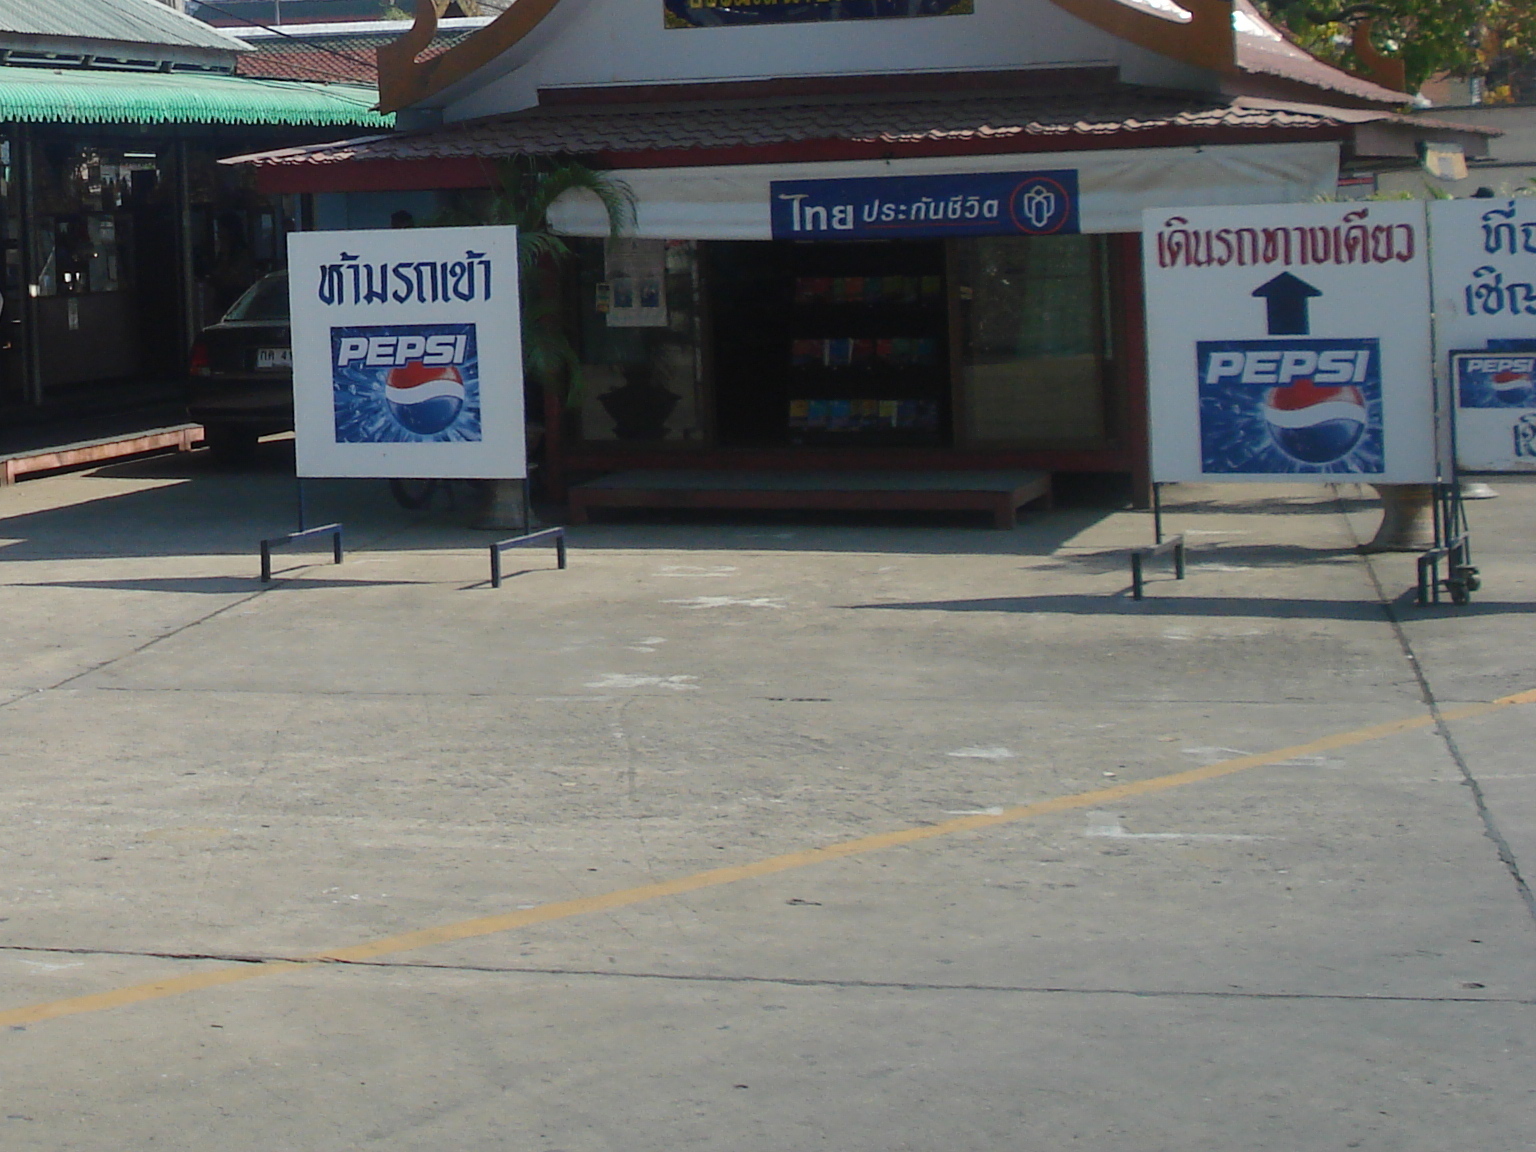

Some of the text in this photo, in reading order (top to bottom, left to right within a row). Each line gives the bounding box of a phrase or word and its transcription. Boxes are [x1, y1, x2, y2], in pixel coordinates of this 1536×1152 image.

[863, 195, 1000, 223] ประกันชีวิต
[1156, 207, 1415, 268] เดินรถทางเดียว
[318, 250, 492, 306] ห้ามรถเข้า
[337, 335, 467, 366] PEPSI
[1467, 358, 1534, 373] PEPSI
[1205, 350, 1370, 385] PEPSI
